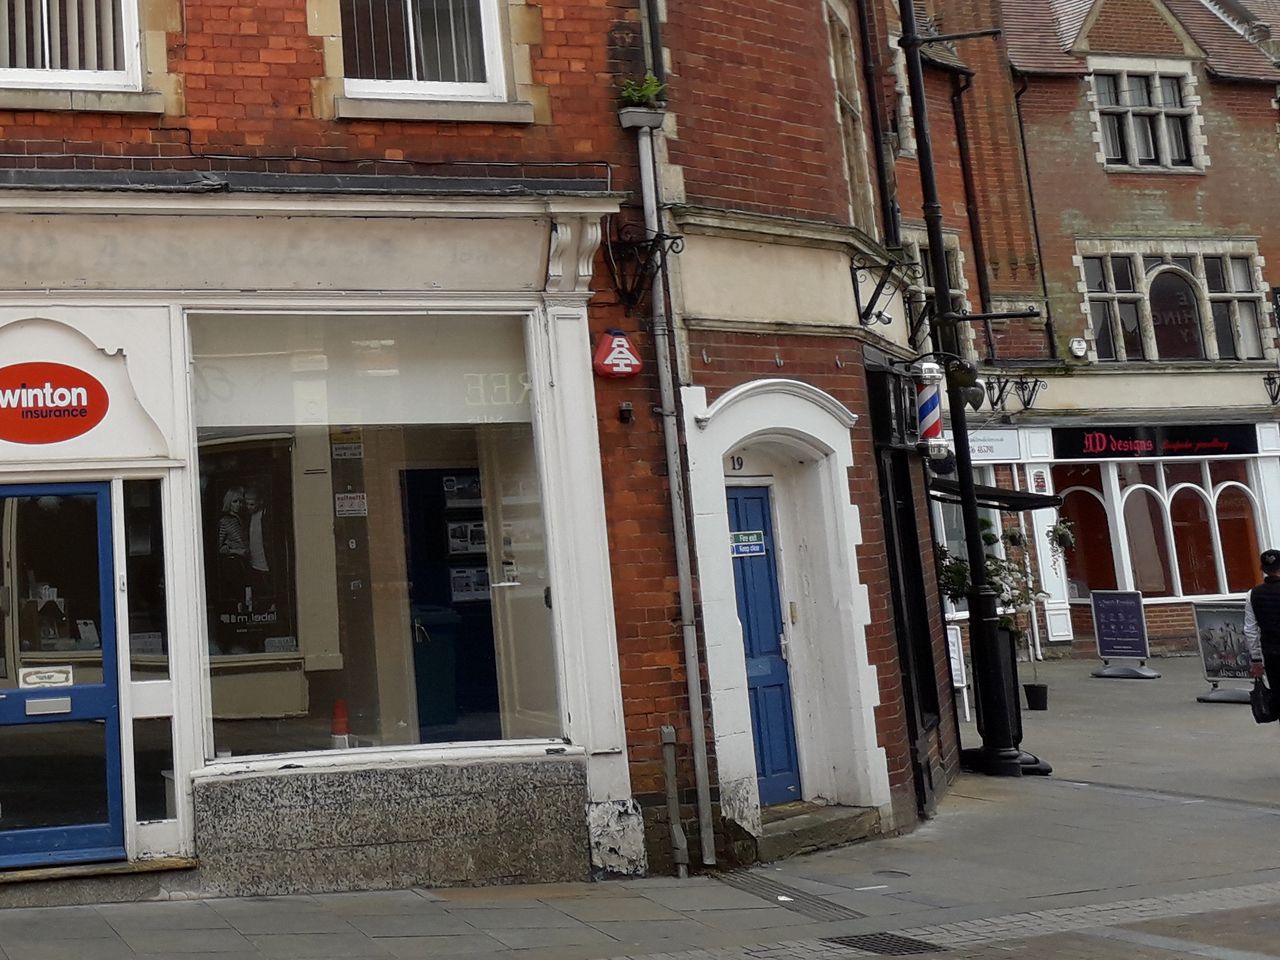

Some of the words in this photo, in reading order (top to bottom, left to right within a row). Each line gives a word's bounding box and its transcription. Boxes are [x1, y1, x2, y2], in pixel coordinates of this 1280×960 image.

[21, 408, 88, 419] insurance
[1109, 434, 1154, 457] designs
[730, 455, 744, 470] 19
